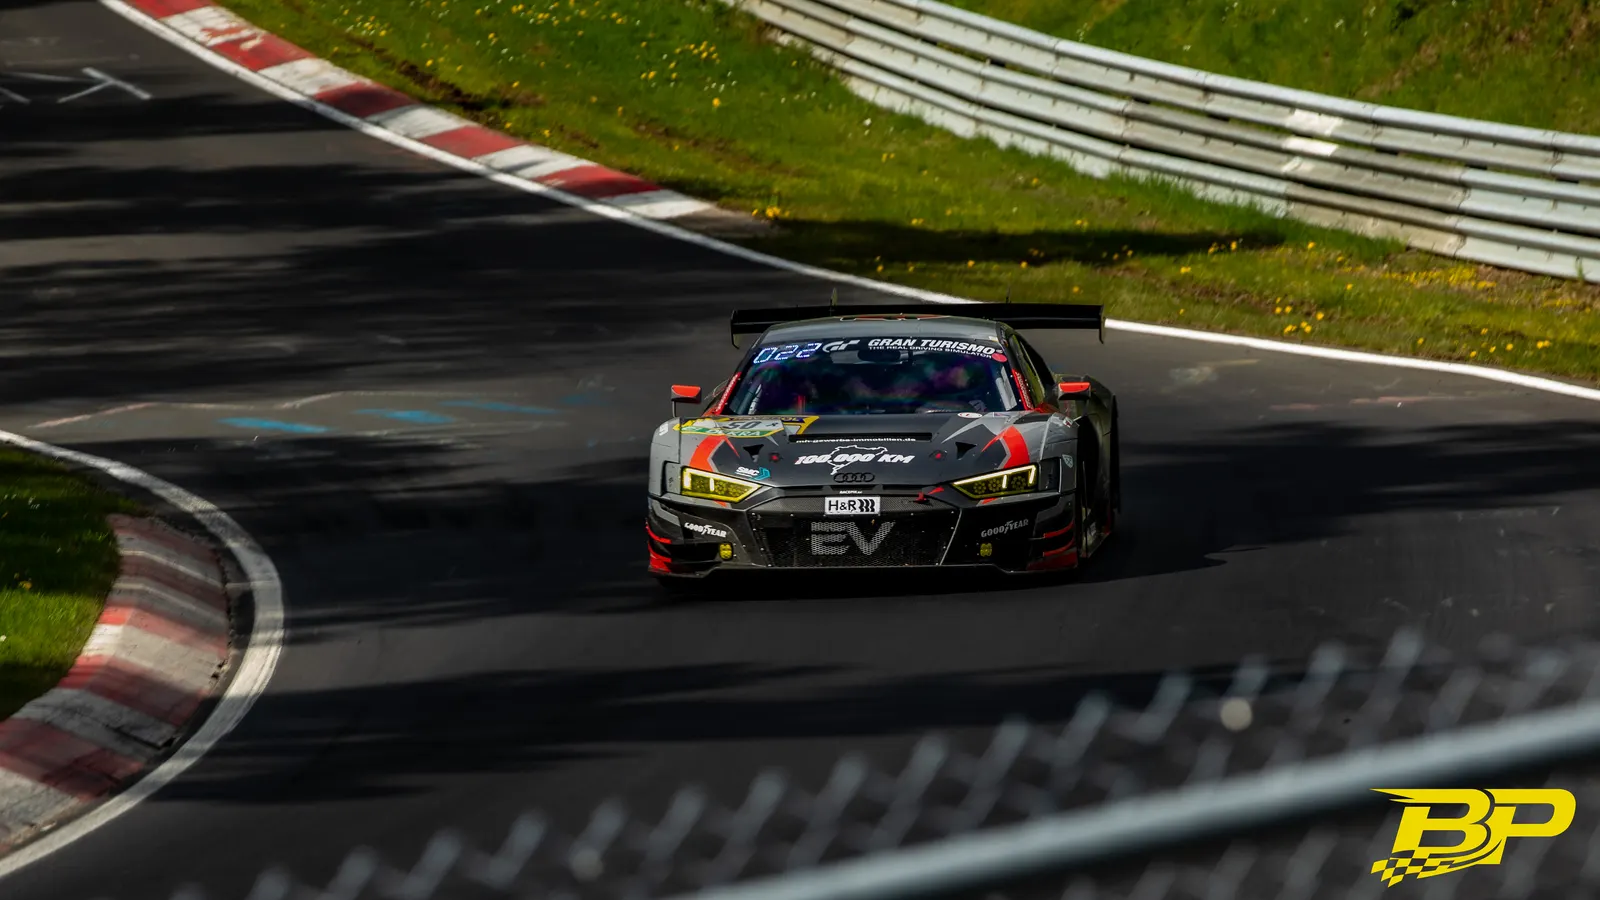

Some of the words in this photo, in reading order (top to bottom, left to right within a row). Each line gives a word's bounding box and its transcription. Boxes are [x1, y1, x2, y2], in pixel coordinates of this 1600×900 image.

[753, 342, 822, 364] 022
[868, 338, 917, 347] GRAN
[919, 339, 996, 355] TURISMO
[945, 348, 993, 359] SIMULATOR
[794, 453, 876, 465] 100.000
[877, 453, 916, 463] KM
[735, 466, 760, 476] SMC
[828, 500, 857, 511] H&R
[684, 522, 727, 538] GOODYEAR
[981, 519, 1029, 538] GOODYEAR
